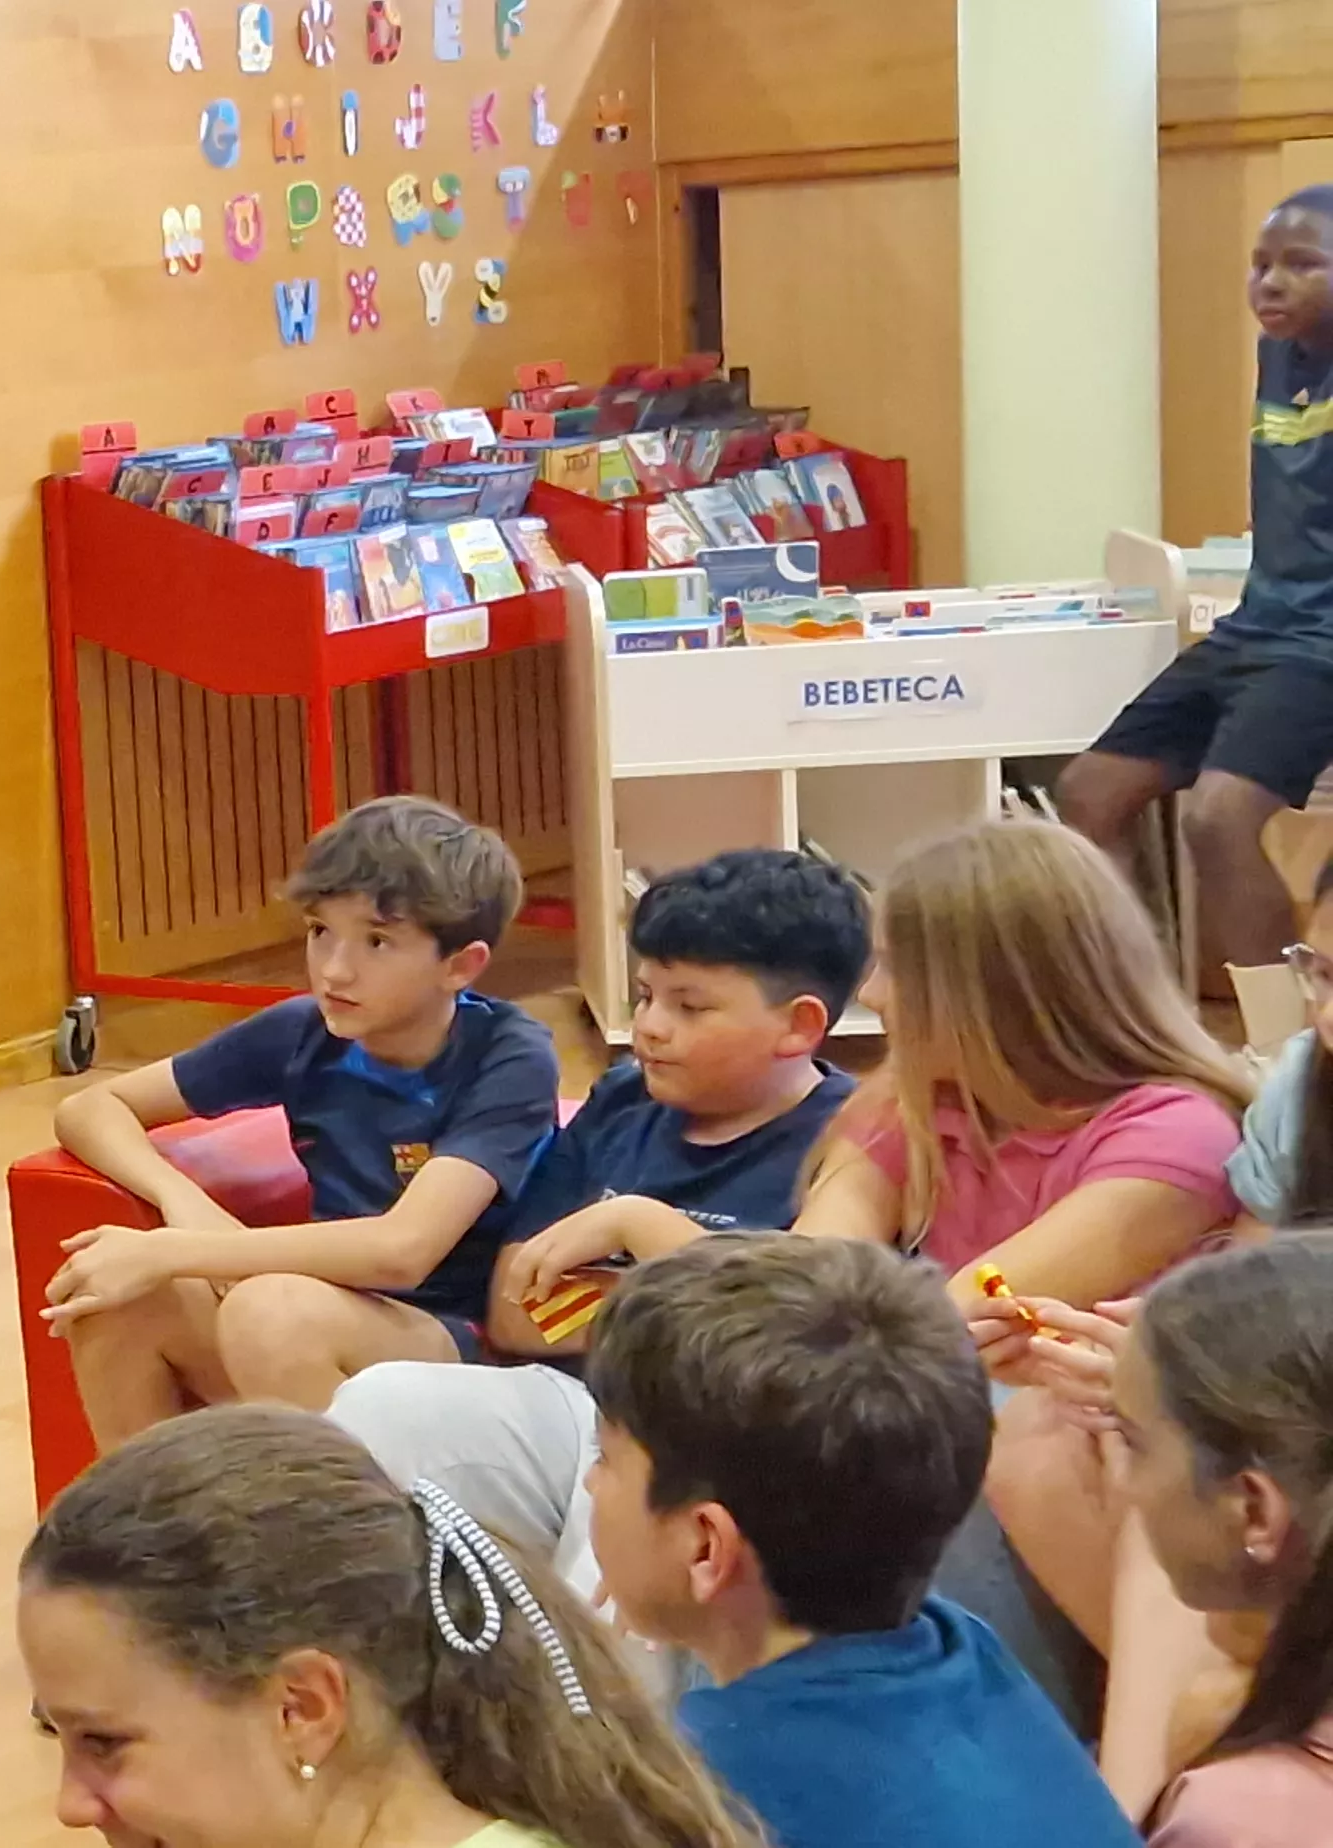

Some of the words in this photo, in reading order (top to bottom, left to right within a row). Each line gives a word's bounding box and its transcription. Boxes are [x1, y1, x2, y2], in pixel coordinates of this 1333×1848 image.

[168, 8, 203, 72] A
[199, 97, 241, 168] G
[395, 83, 426, 150] J
[470, 91, 502, 152] K
[532, 84, 559, 147] L
[286, 180, 322, 251] P
[274, 277, 319, 346] W
[346, 265, 380, 334] X
[417, 259, 452, 327] Y
[473, 256, 508, 325] Z
[326, 396, 337, 414] C
[104, 427, 115, 448] A
[523, 419, 534, 436] T
[357, 447, 370, 466] H
[187, 476, 203, 494] C
[262, 472, 273, 492] E
[317, 468, 331, 486] J
[324, 512, 338, 532] F
[804, 674, 965, 707] BEBETECA
